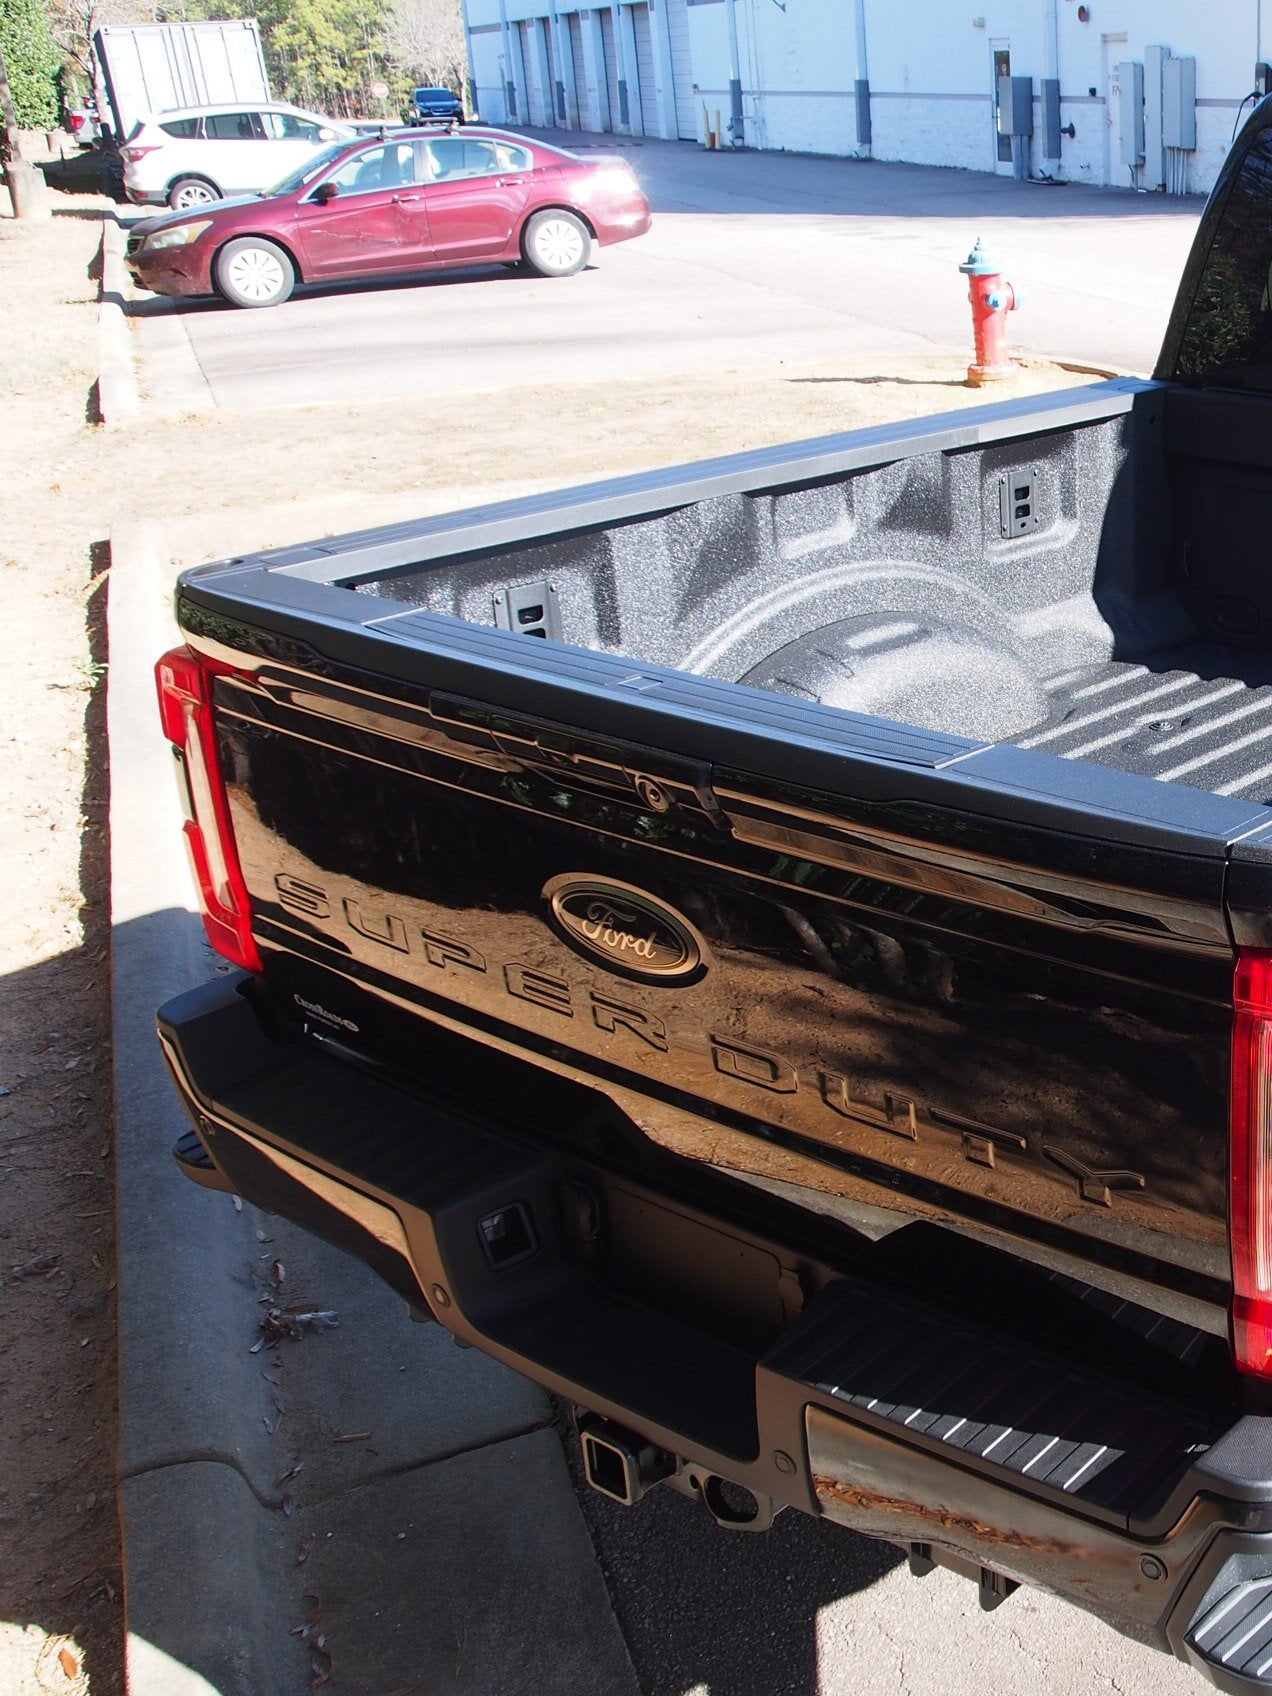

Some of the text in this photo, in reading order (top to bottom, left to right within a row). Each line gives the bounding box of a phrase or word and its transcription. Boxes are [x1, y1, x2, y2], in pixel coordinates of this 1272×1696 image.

[581, 901, 658, 959] Ford
[274, 872, 1146, 1209] SUPER DUTY
